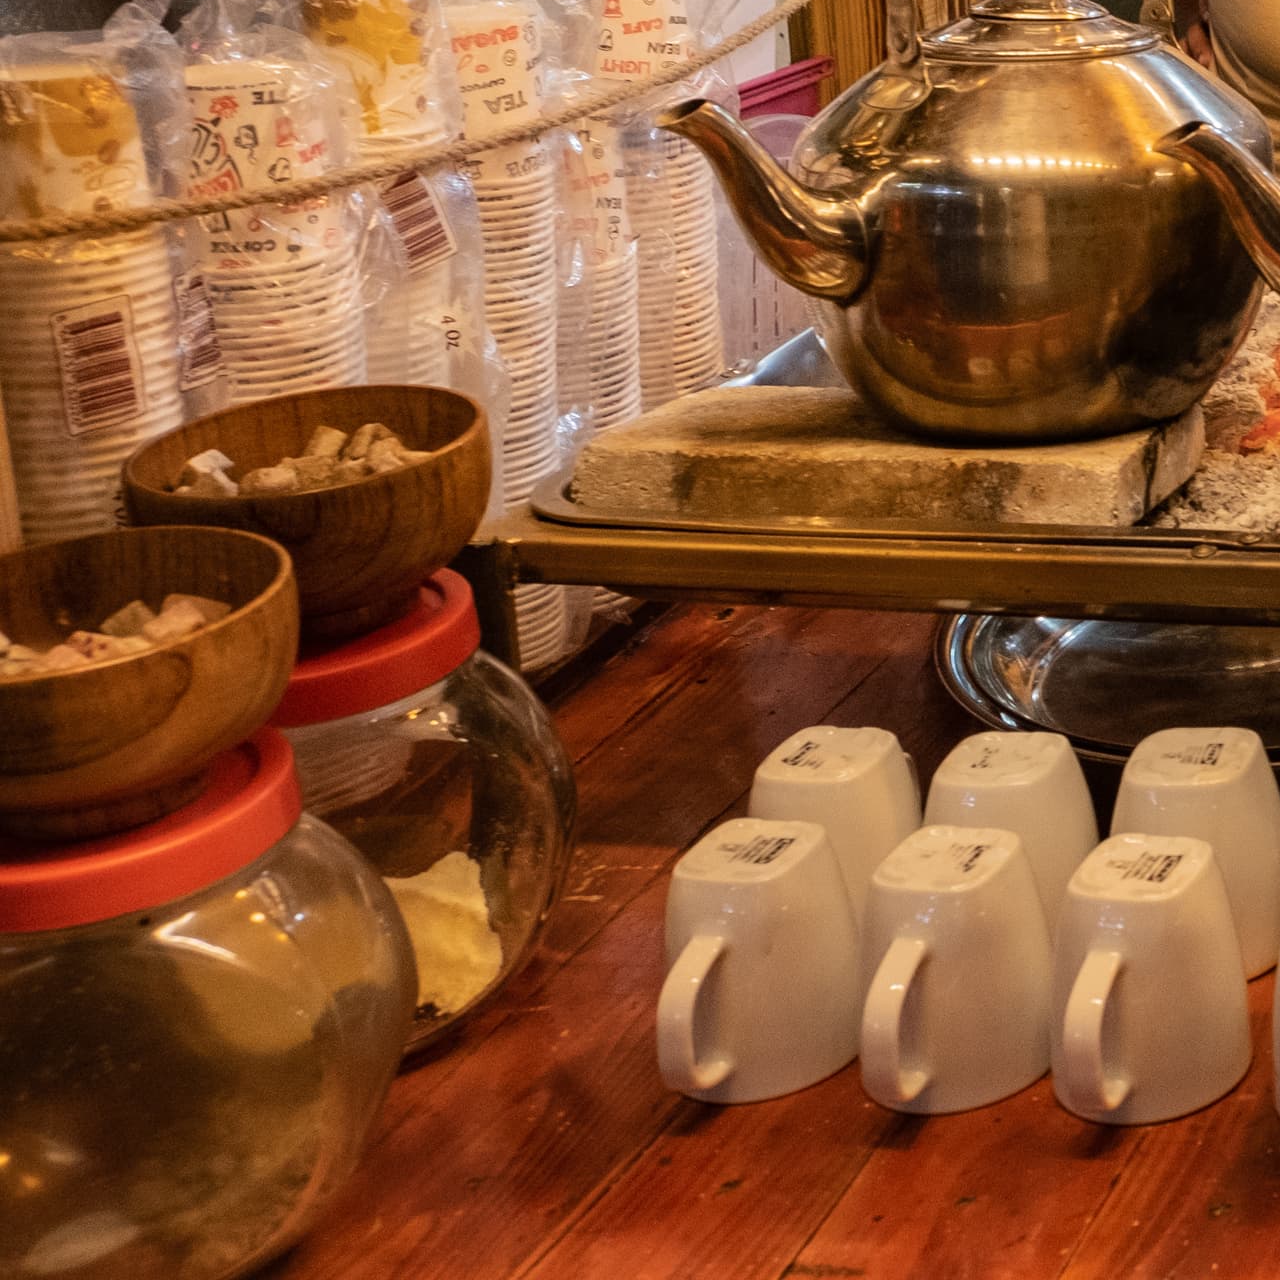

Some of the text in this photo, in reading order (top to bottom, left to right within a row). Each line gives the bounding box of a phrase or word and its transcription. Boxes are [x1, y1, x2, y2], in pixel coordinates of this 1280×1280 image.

[600, 58, 651, 75] LIGHT
[482, 90, 529, 115] TEA
[441, 315, 457, 325] 4
